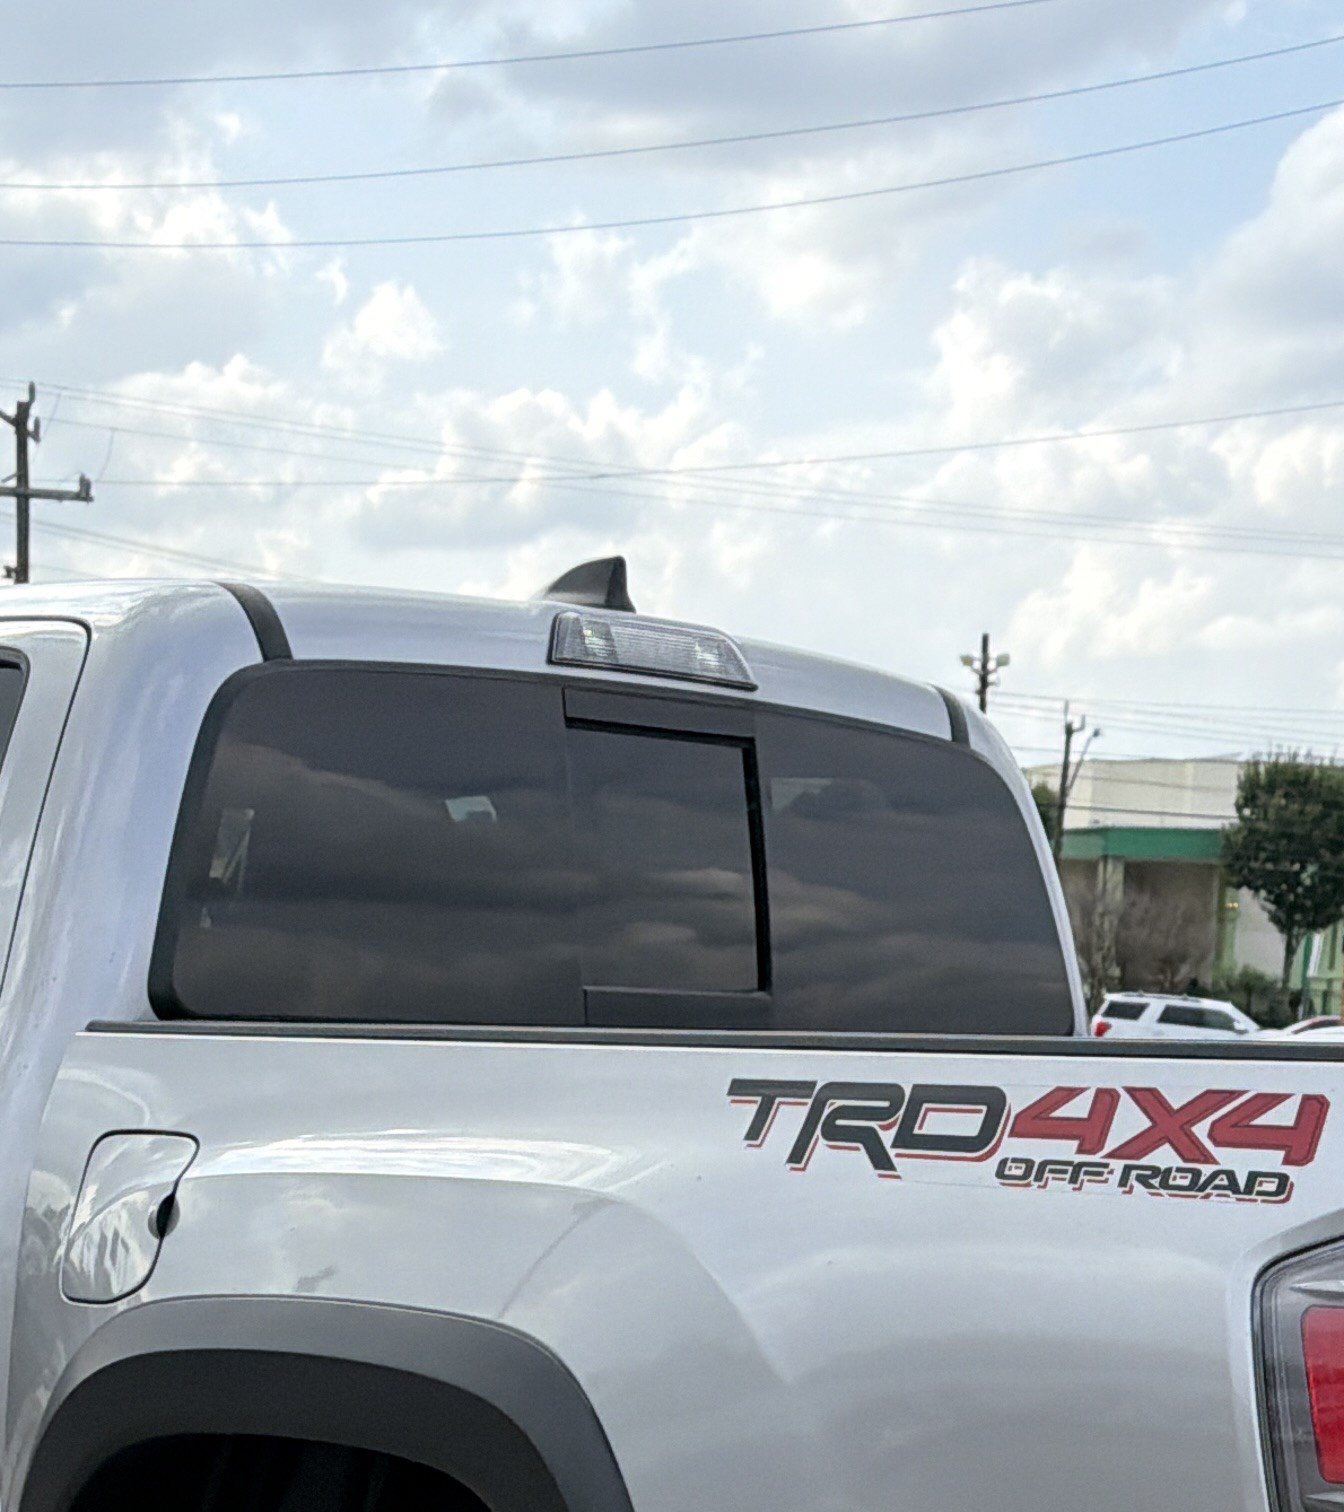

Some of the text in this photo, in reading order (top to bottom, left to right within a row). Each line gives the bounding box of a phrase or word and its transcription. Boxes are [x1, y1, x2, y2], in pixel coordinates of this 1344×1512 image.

[727, 1078, 1332, 1180] TRD 4X4
[994, 1157, 1296, 1204] OFF ROAD
